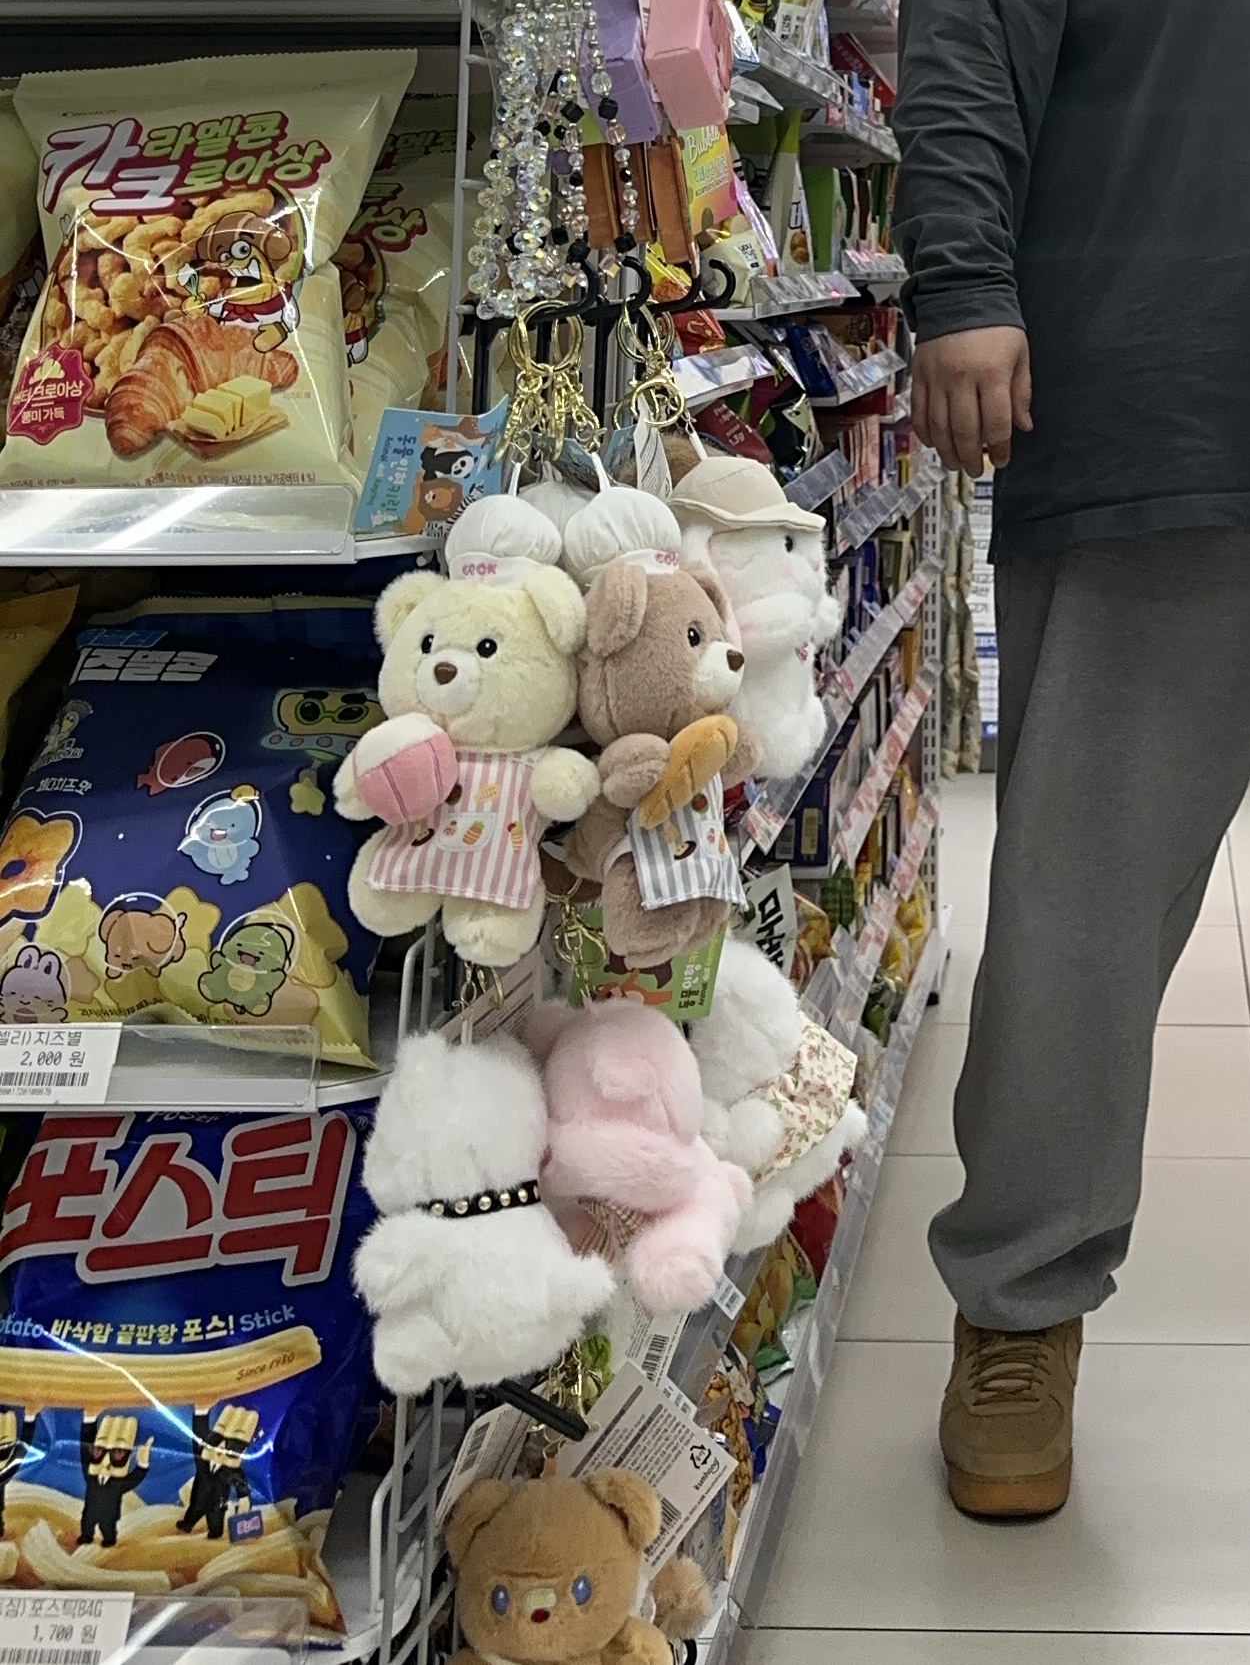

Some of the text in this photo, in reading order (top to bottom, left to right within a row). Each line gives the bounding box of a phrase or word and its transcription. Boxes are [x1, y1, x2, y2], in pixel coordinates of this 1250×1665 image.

[20, 1050, 86, 1068] 2,000 원
[0, 1111, 355, 1286] 포스틱
[50, 1313, 235, 1347] 바삭함 끝판왕 포스!
[239, 1303, 297, 1333] Stick
[235, 1350, 297, 1382] Since 1980
[32, 1623, 98, 1644] 1,700 원
